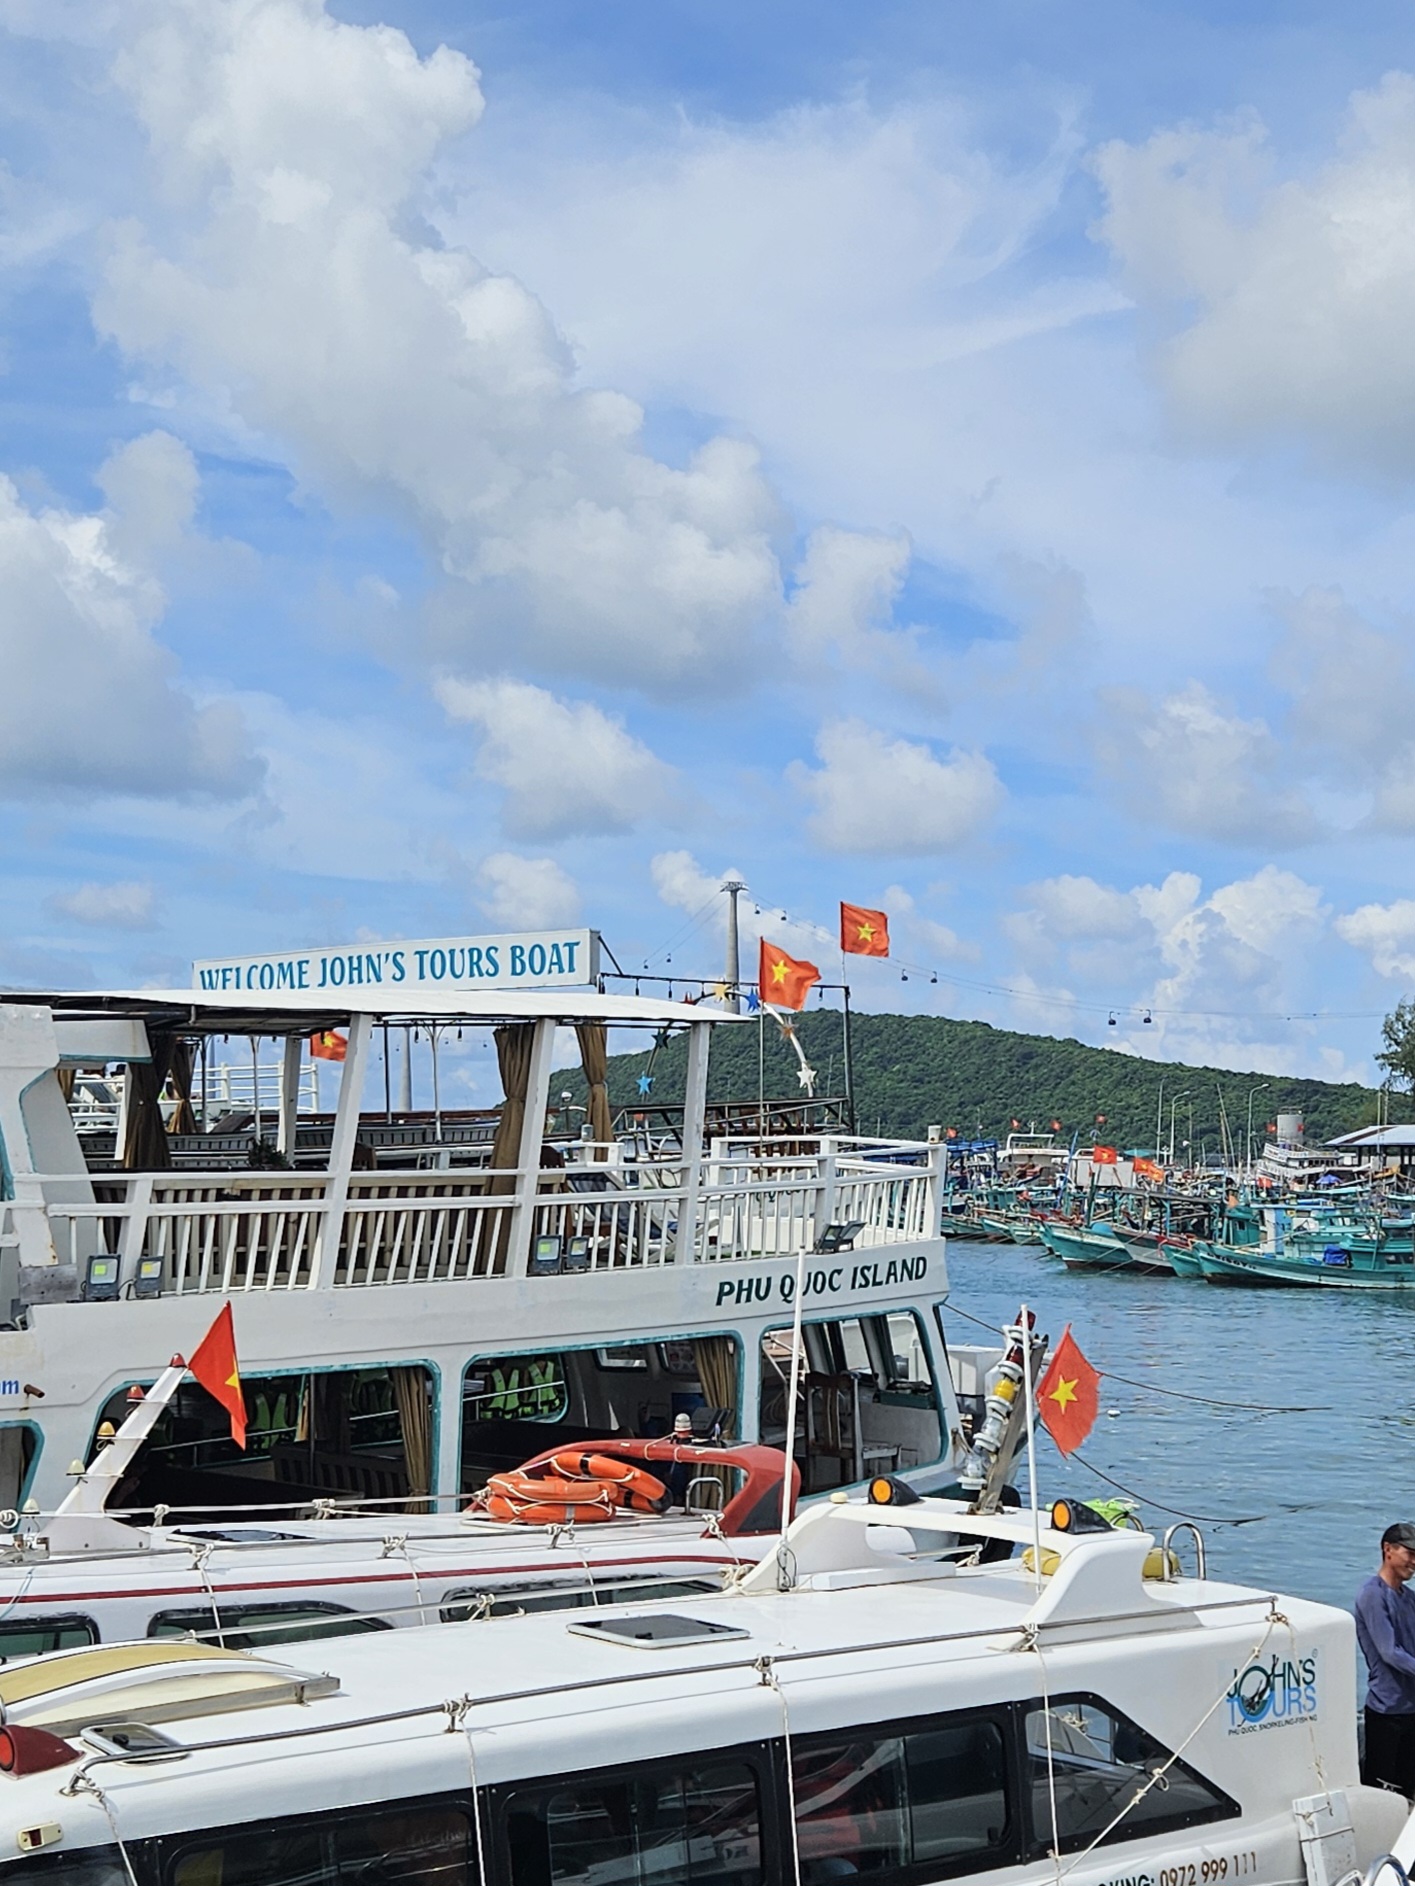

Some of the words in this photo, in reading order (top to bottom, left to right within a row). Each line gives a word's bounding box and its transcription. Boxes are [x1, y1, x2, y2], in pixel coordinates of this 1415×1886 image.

[317, 951, 406, 988] JOHN'S
[413, 945, 500, 980] TOURS
[510, 940, 582, 976] BOAT
[715, 1276, 772, 1306] PHU
[850, 1256, 928, 1290] ISLAND
[1160, 1863, 1197, 1886] 0972
[1201, 1857, 1228, 1884] 999
[1233, 1851, 1256, 1877] 111
